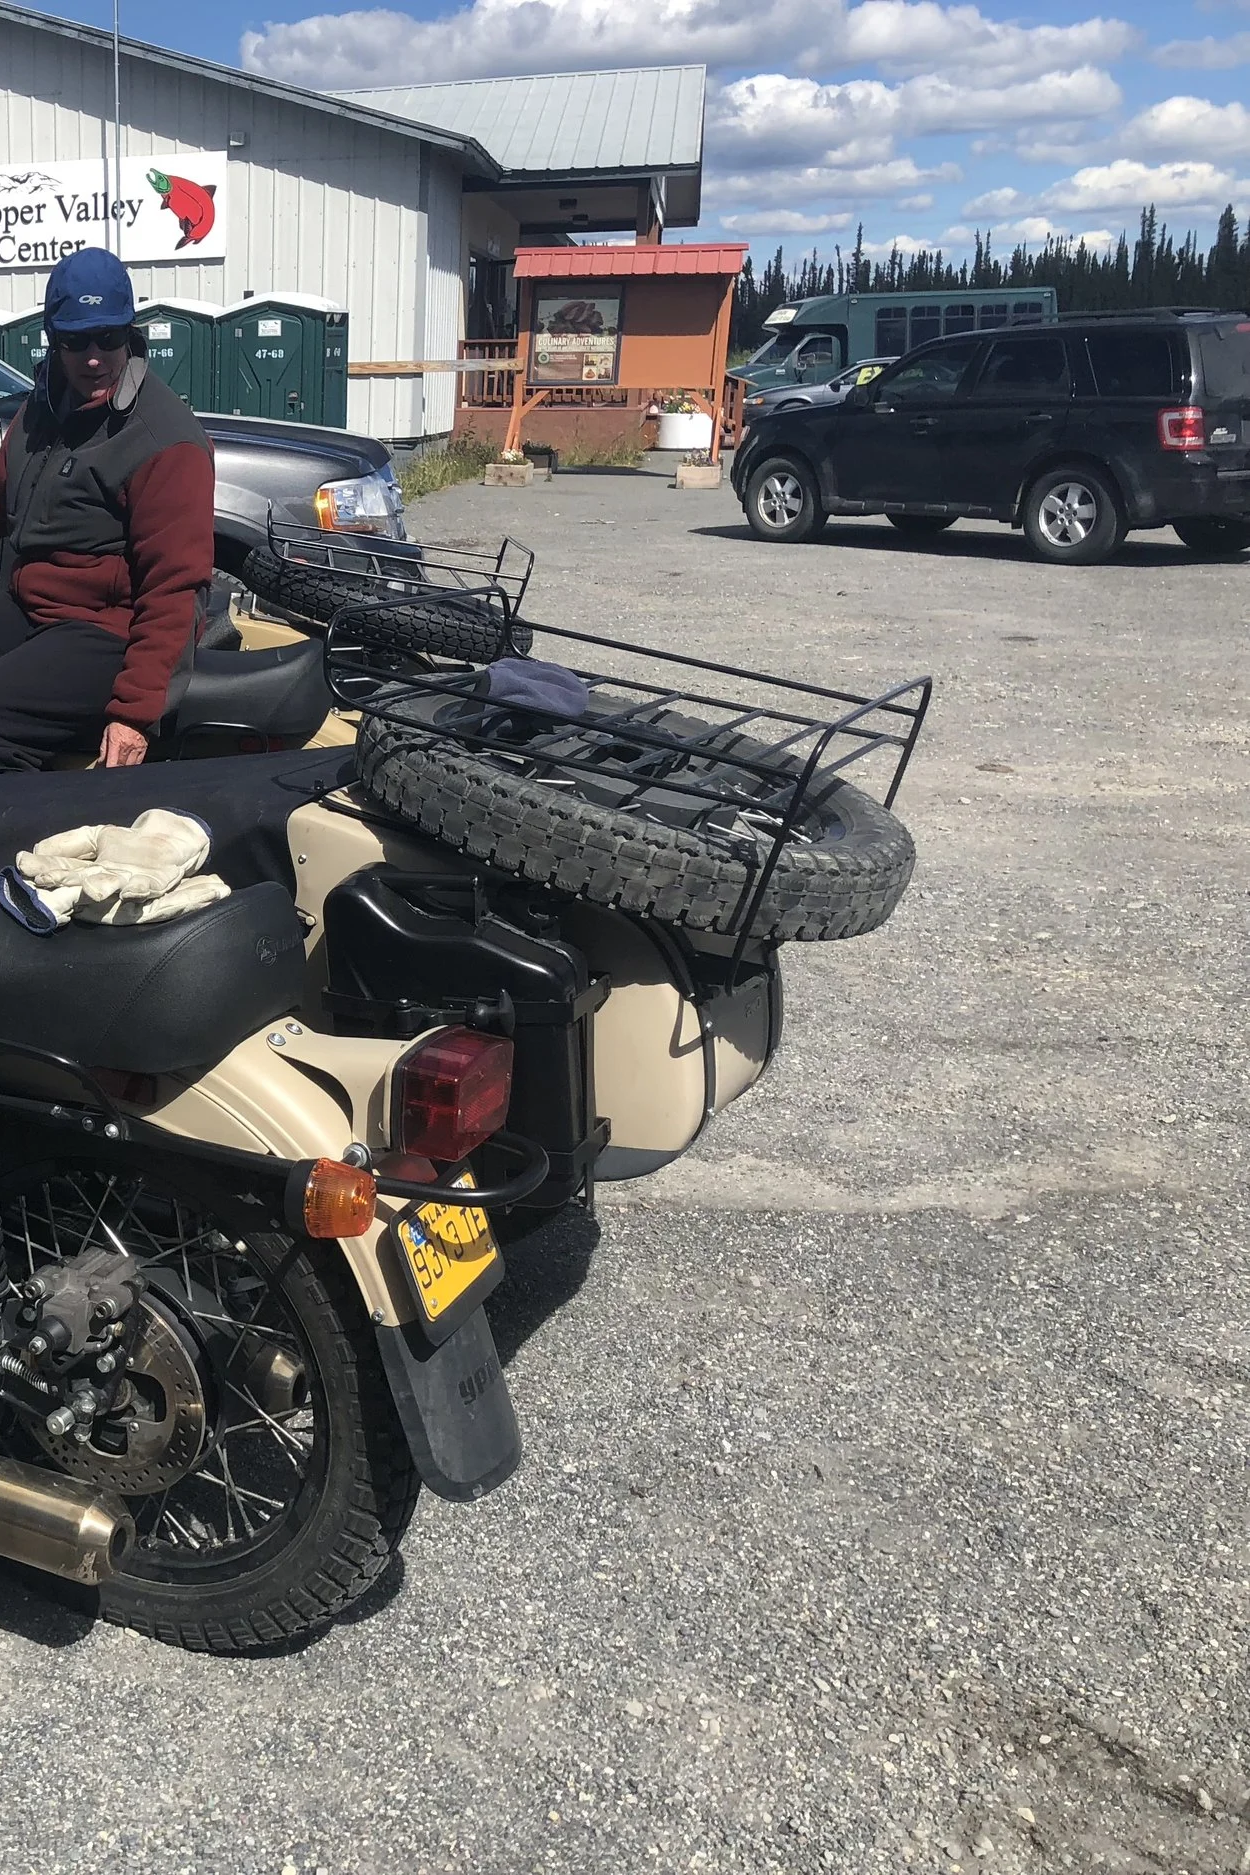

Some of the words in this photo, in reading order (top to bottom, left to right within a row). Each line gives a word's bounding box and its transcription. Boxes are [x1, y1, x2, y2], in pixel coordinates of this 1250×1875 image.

[54, 192, 144, 228] Valley
[79, 294, 103, 305] OR
[538, 336, 570, 346] CULINARY
[571, 336, 615, 346] ADVENTURES
[423, 1203, 451, 1228] ALAS
